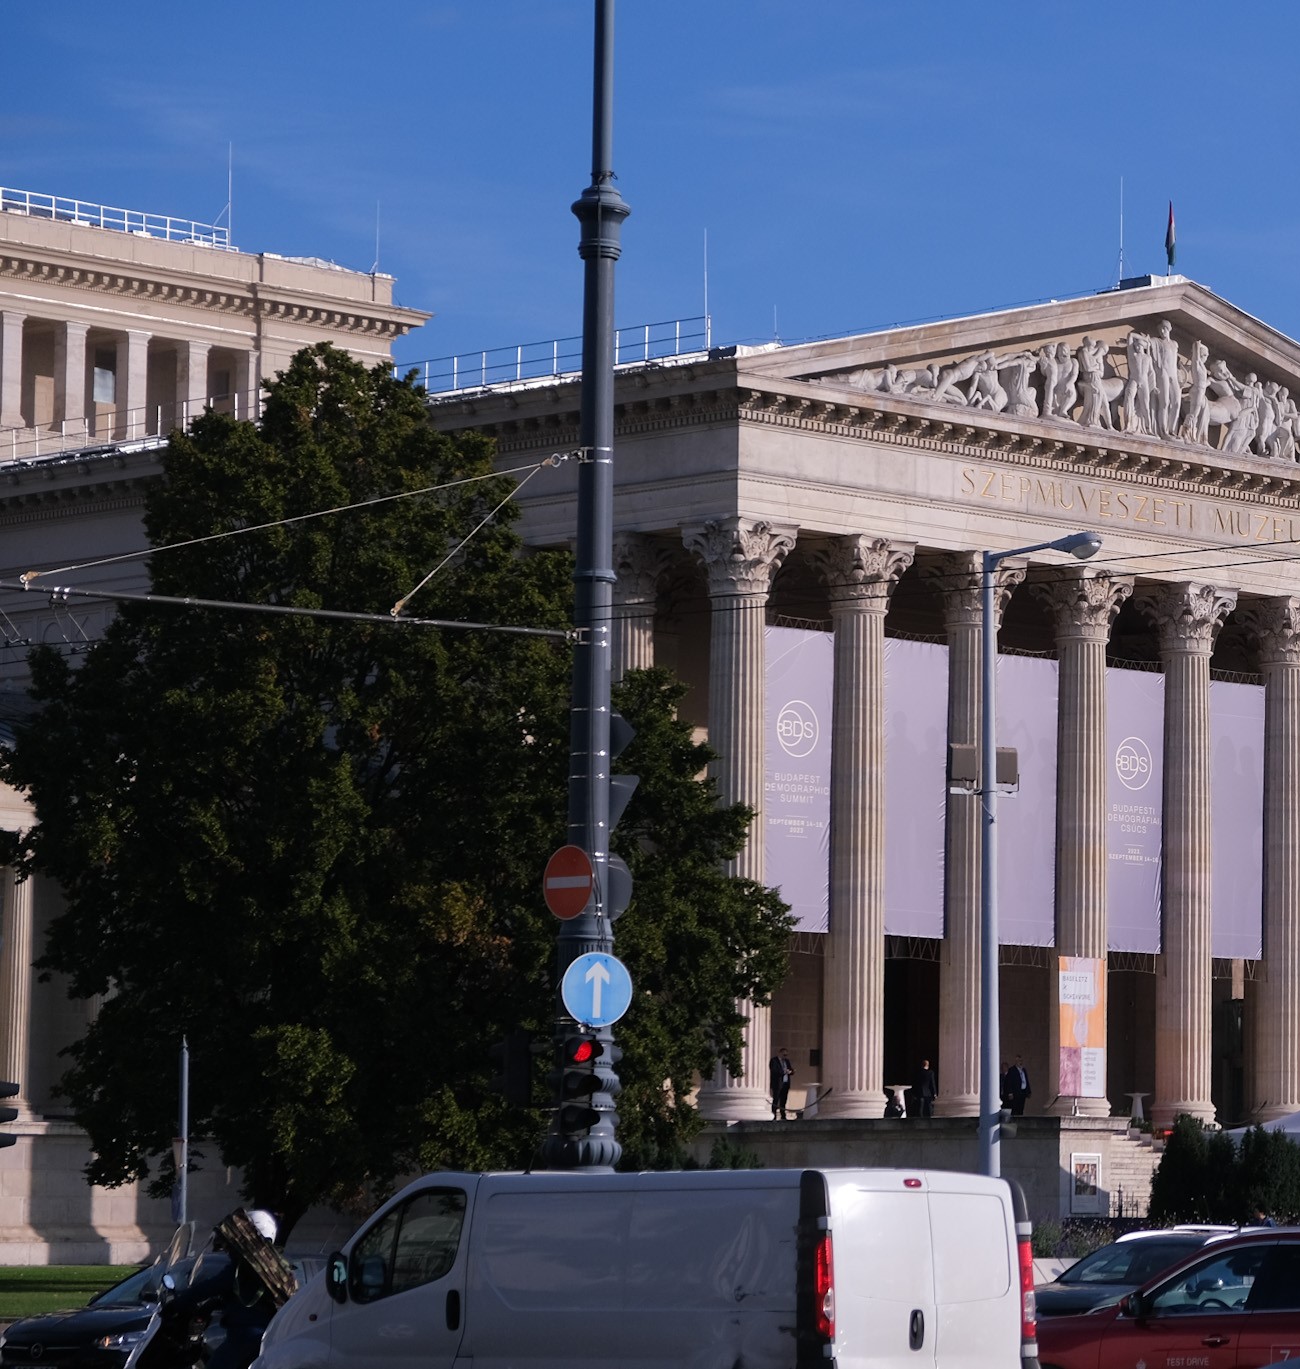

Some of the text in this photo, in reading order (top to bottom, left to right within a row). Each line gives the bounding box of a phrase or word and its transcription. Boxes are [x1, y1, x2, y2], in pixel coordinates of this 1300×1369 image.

[783, 719, 814, 739] BDS
[1120, 755, 1148, 773] BDS
[774, 772, 821, 784] BUDAPEST
[765, 782, 830, 796] DEMOGRAPHIC
[780, 793, 814, 804] SUMMIT
[1112, 803, 1155, 815] BUDAPESTI
[768, 818, 805, 826] SEPTEMBER
[1120, 823, 1147, 834] CSÚCS
[1108, 853, 1144, 861] SZEPTEMBER
[1166, 1357, 1210, 1367] TEST DRIVE
